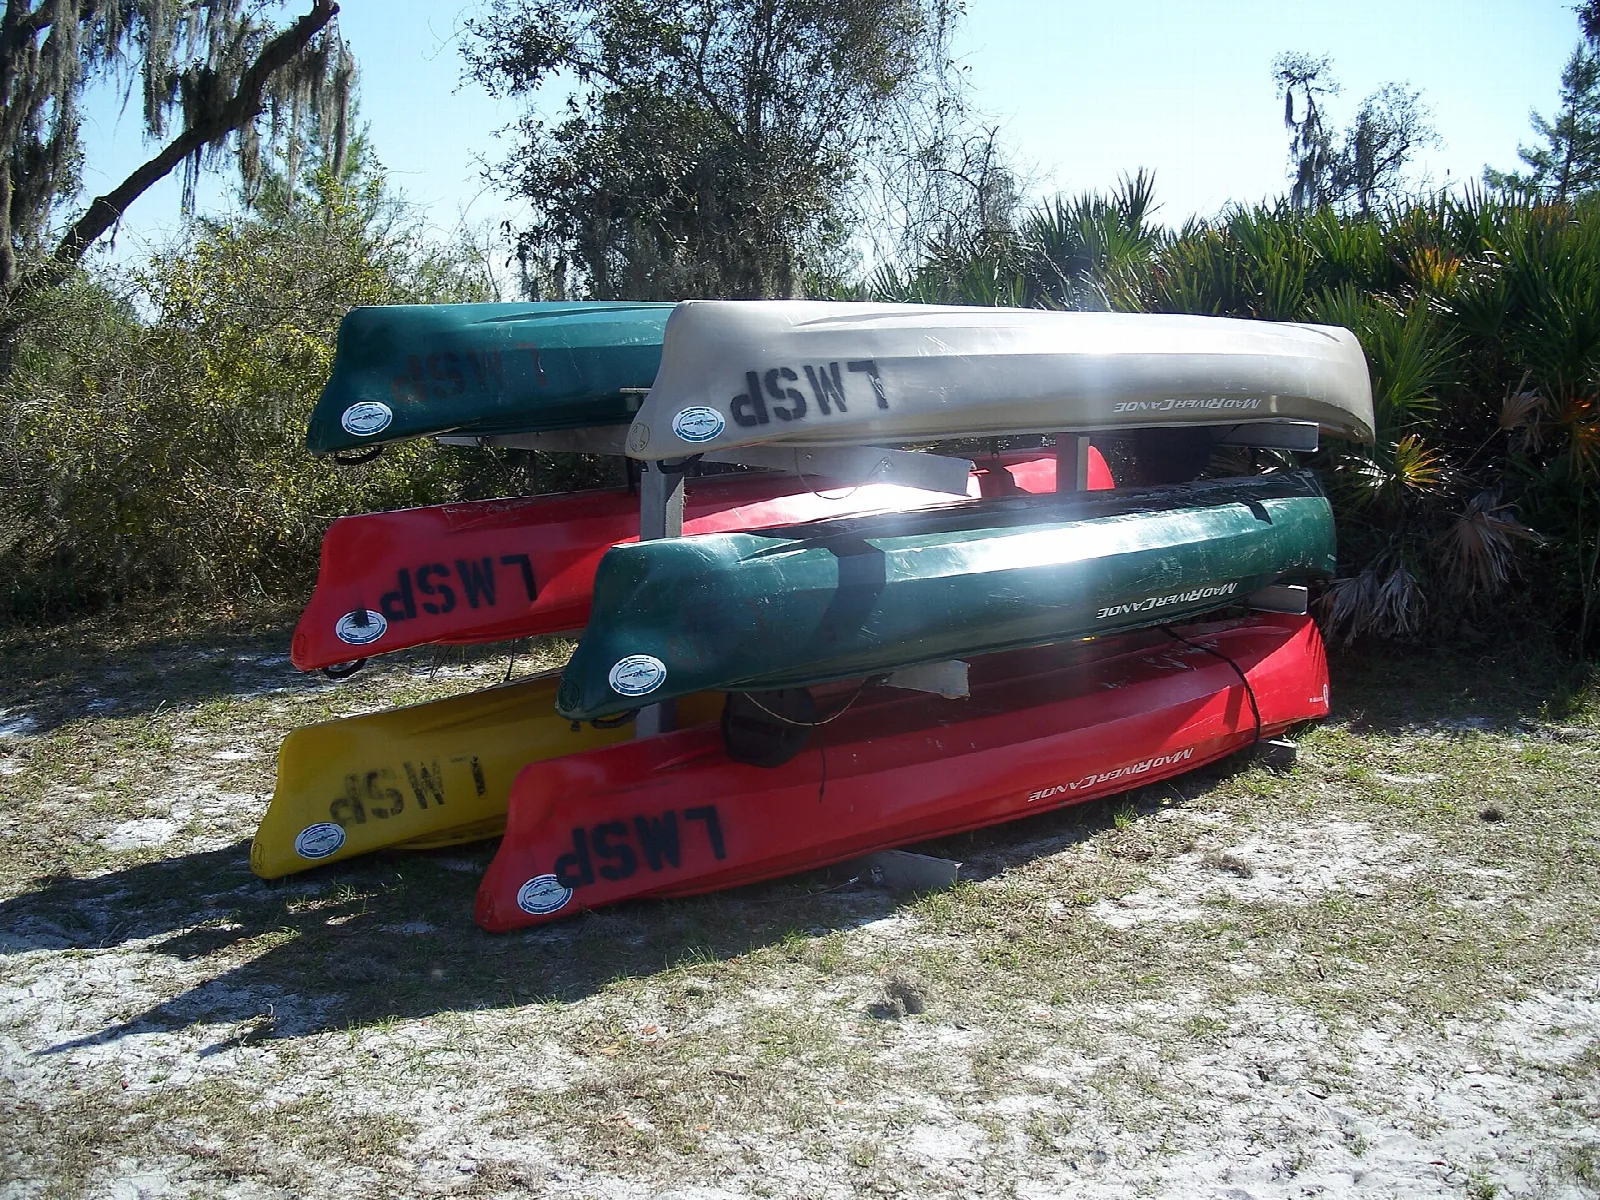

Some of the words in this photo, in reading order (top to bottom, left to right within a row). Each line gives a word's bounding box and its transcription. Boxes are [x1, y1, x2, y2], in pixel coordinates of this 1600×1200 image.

[732, 360, 890, 427] LMSP
[380, 554, 539, 621] LMSP
[329, 756, 486, 828] LMSP
[555, 805, 727, 888] LMSP
